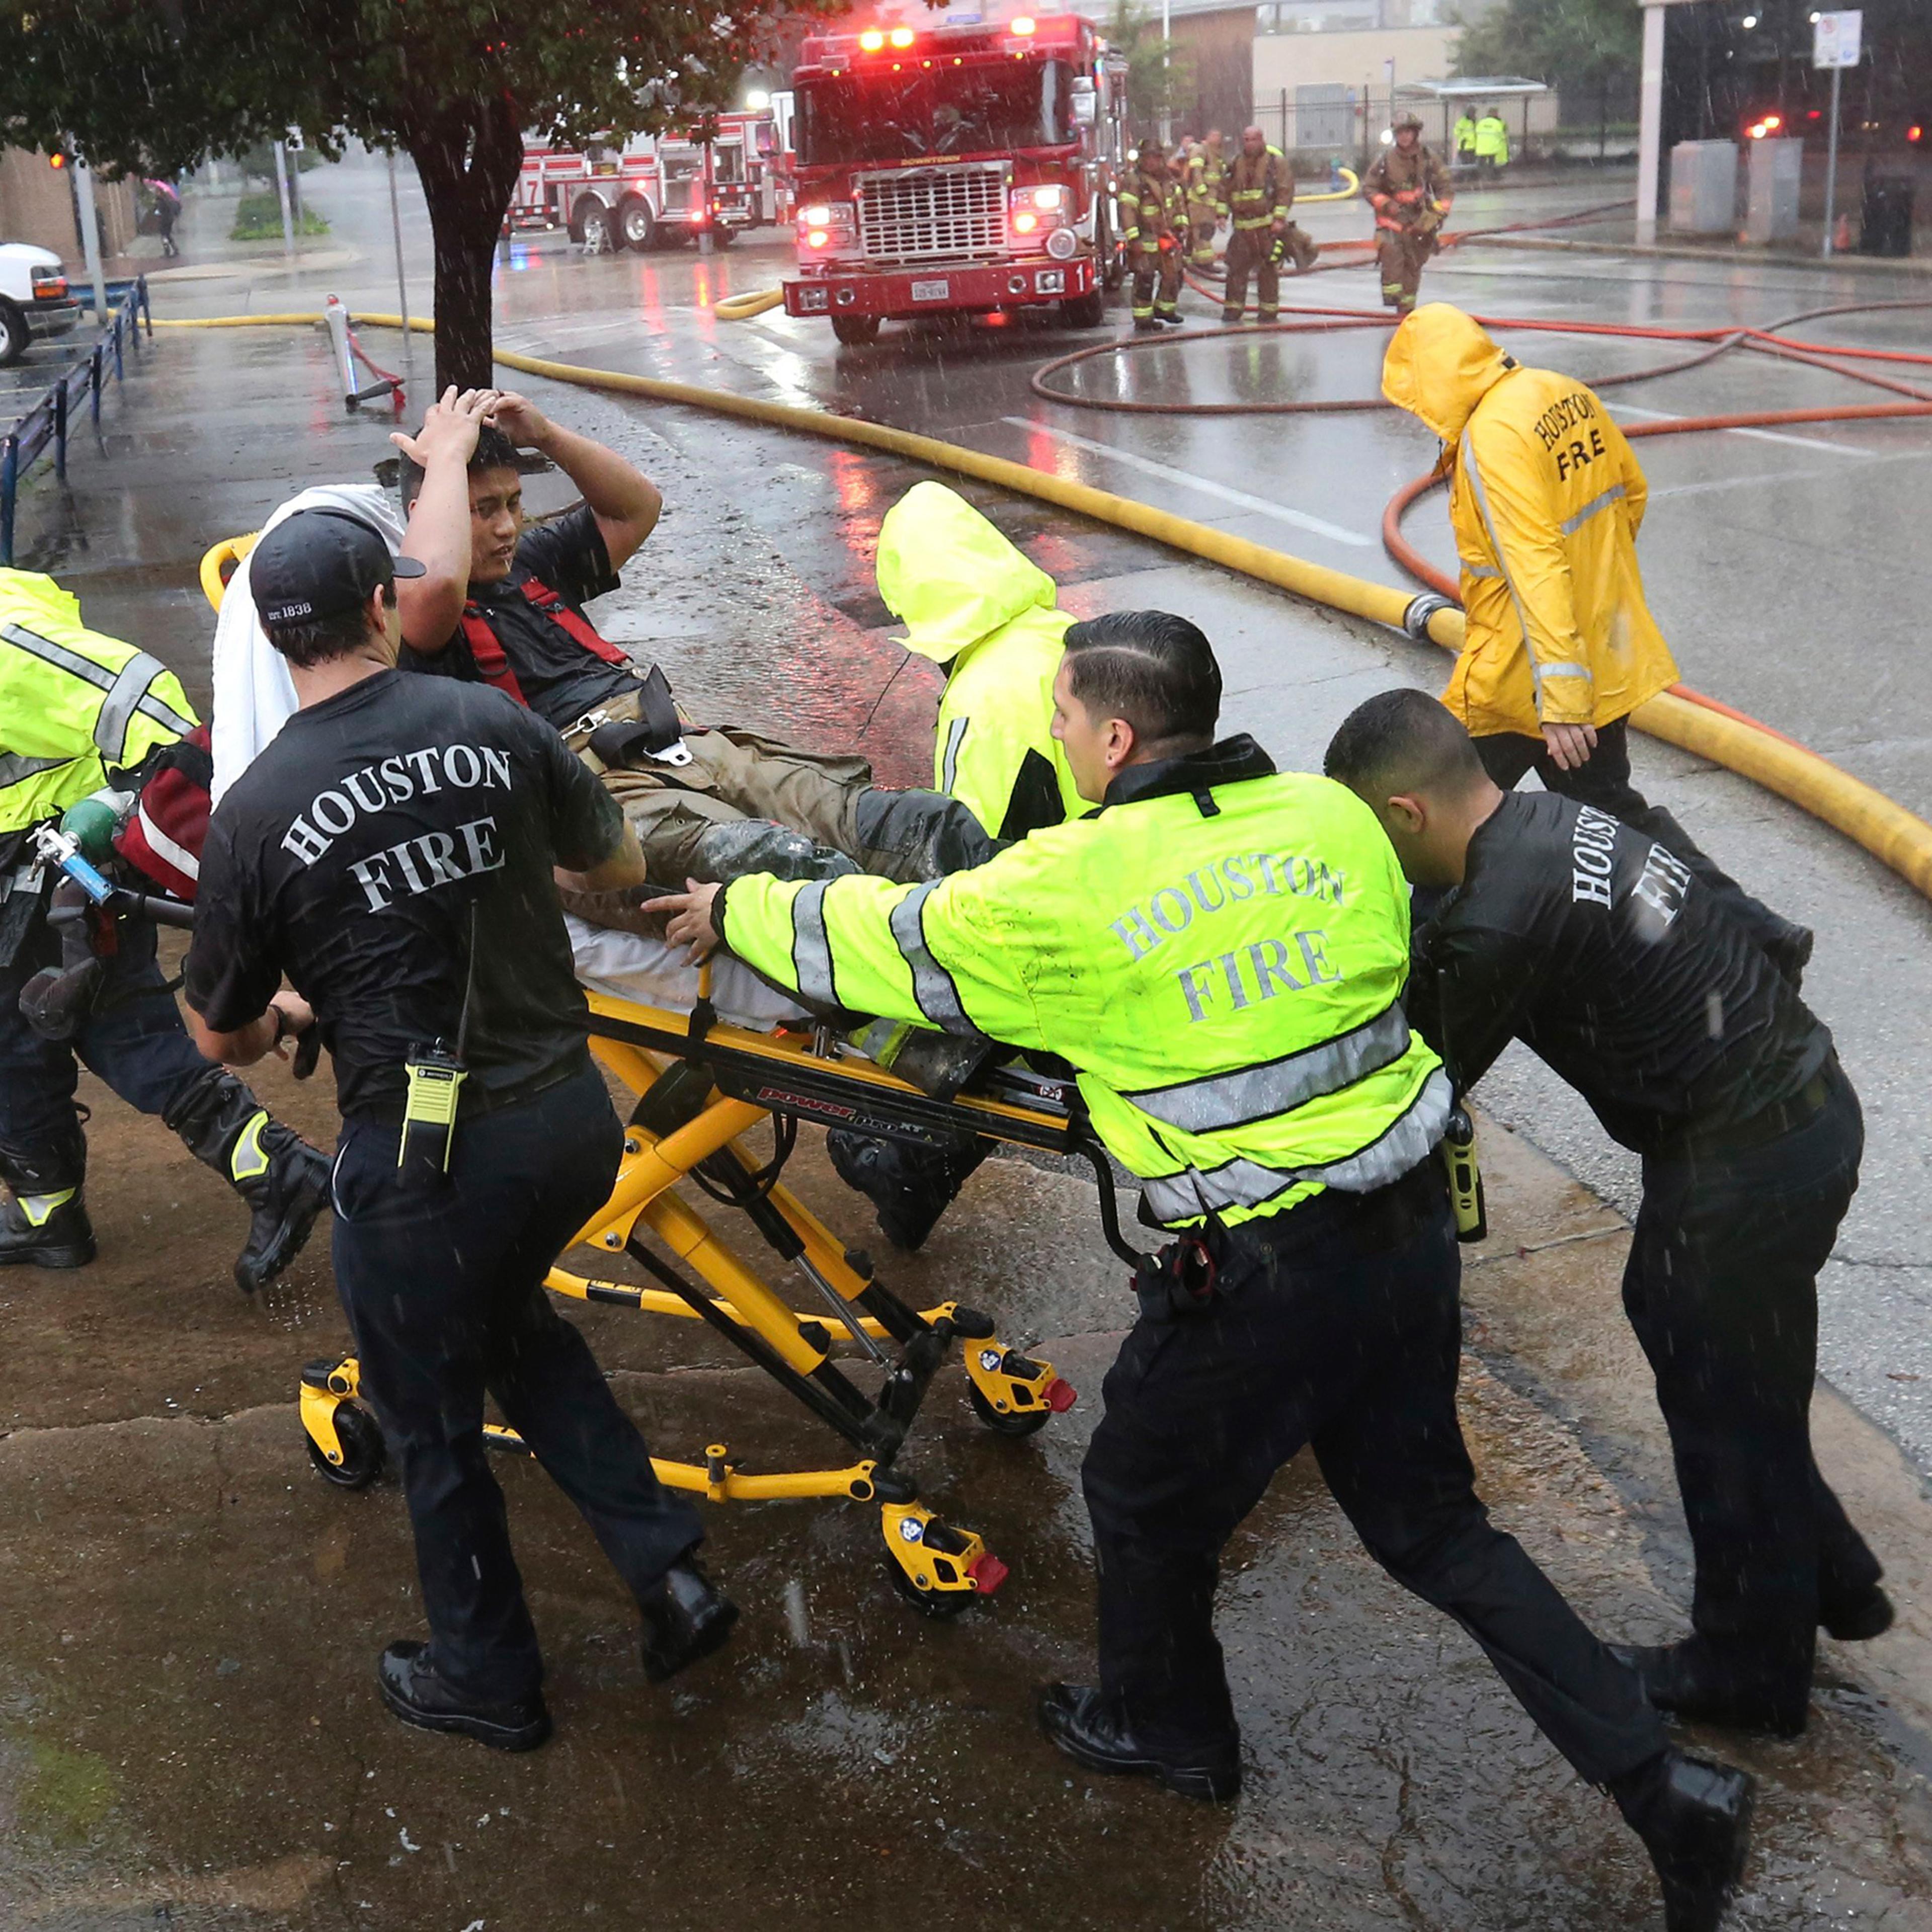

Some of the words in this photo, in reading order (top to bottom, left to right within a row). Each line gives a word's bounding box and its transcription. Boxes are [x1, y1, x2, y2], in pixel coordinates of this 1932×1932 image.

[527, 181, 538, 205] 7
[1076, 264, 1084, 291] 1
[282, 602, 312, 618] 1838
[280, 745, 512, 869] HOUSTON
[347, 817, 506, 914] FIRE
[1108, 853, 1345, 962] HOUSTON
[1631, 842, 1692, 926] FIR
[1175, 930, 1344, 1023] FIRE
[899, 1121, 924, 1133] XT
